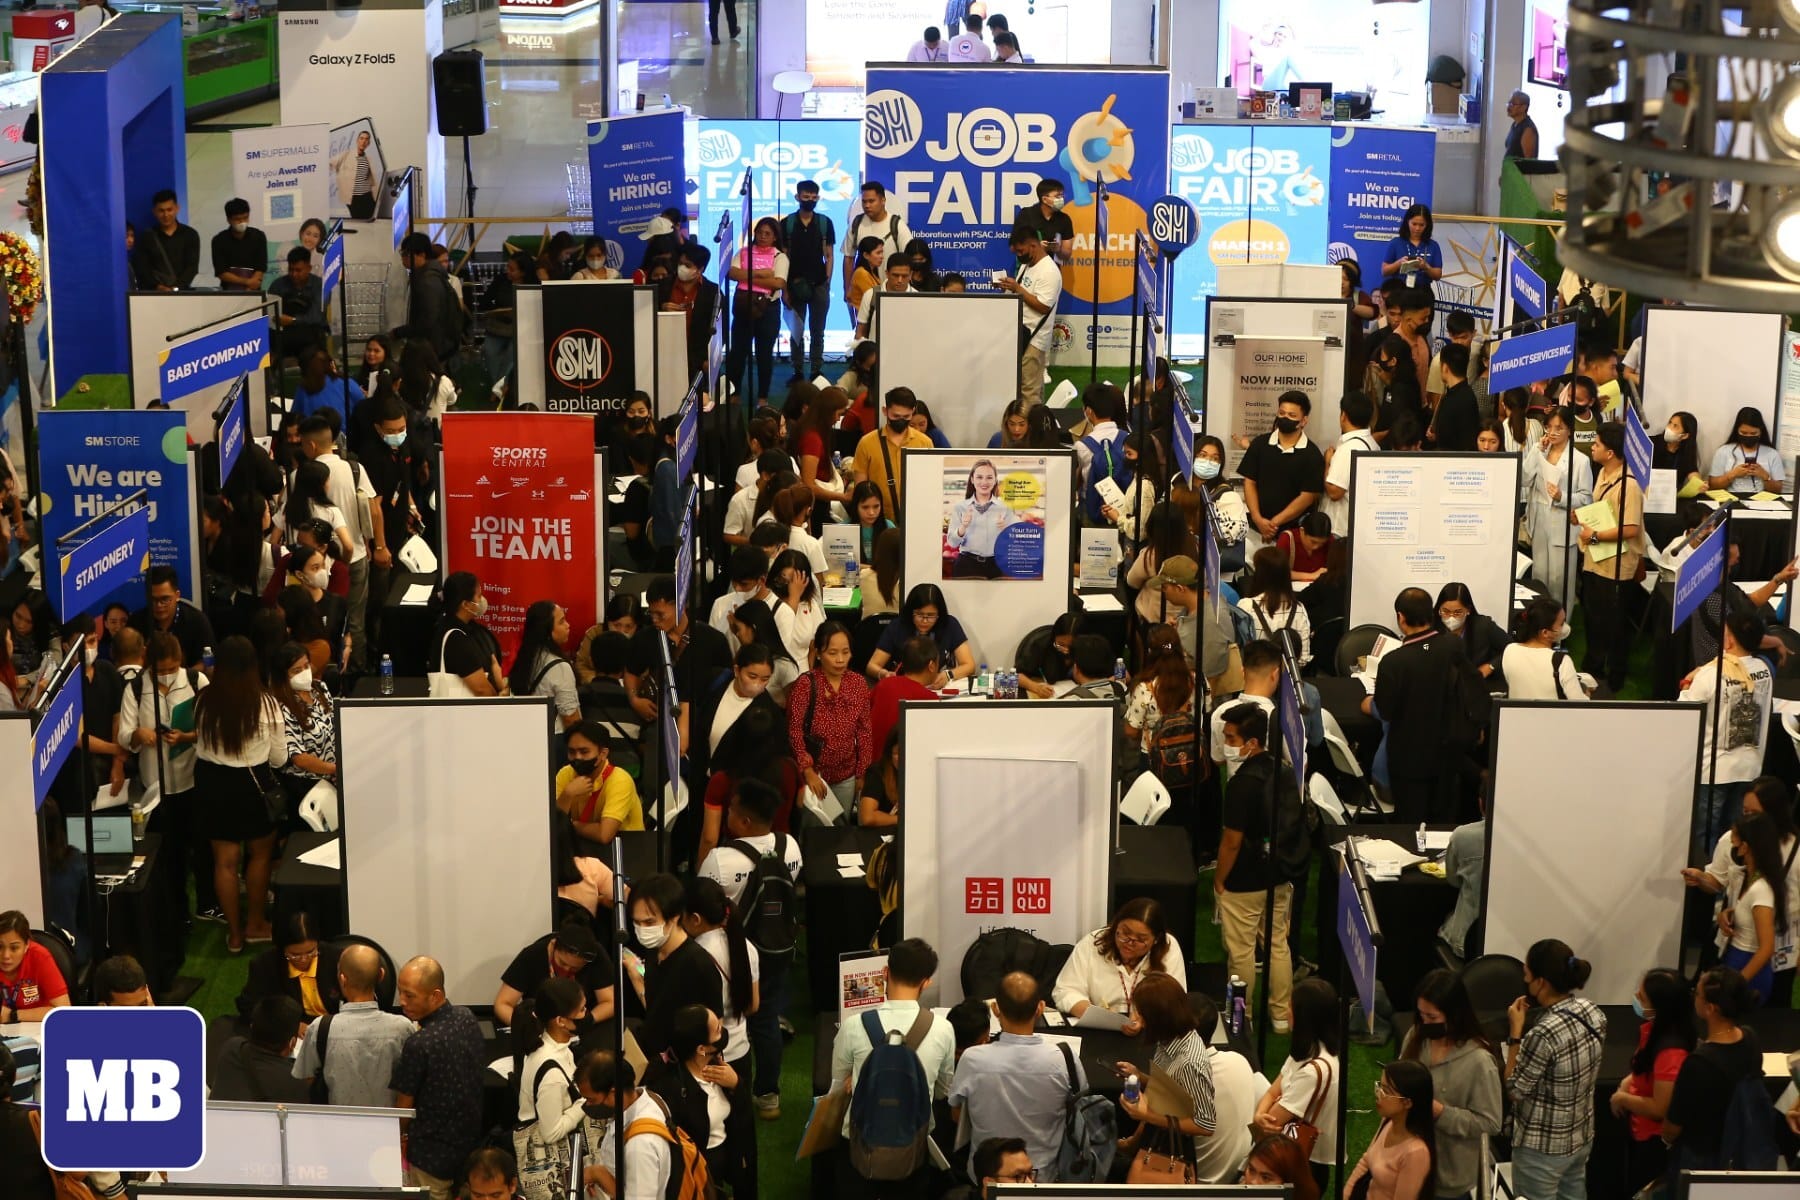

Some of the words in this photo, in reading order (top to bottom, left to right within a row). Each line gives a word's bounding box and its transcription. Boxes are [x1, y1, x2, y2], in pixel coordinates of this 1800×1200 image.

[309, 54, 352, 66] Galaxy
[354, 54, 362, 64] Z
[363, 53, 396, 64] Fold5
[866, 97, 914, 150] SM
[925, 107, 1059, 168] JOB
[621, 143, 633, 151] SM
[246, 151, 261, 160] SM
[741, 141, 829, 173] JOB
[1213, 146, 1300, 177] JOB
[248, 170, 261, 178] Are
[262, 169, 278, 179] you
[278, 164, 317, 176] AweSM?
[623, 173, 639, 183] We
[640, 172, 655, 180] are
[266, 181, 284, 189] Join
[285, 178, 298, 187] us!
[608, 180, 672, 202] HIRING!
[1178, 175, 1278, 205] FAIR
[1365, 182, 1381, 192] We
[1383, 185, 1400, 193] are
[894, 170, 1043, 225] FAIR
[1347, 193, 1415, 210] HIRING!
[1152, 202, 1188, 244] SM
[1360, 212, 1372, 220] Join
[952, 230, 970, 239] with
[971, 230, 993, 239] PSAC
[934, 241, 988, 249] PHILEXPORT
[1211, 241, 1273, 252] MARCH
[1277, 241, 1286, 251] 1
[167, 359, 200, 384] BABY
[200, 338, 262, 370] COMPANY
[556, 336, 602, 380] SM
[1254, 354, 1274, 362] OUR
[1278, 354, 1306, 362] HOME
[1492, 358, 1518, 374] MYRIAD
[1518, 356, 1529, 367] ICT
[1529, 347, 1560, 365] SERVICES
[1240, 375, 1271, 385] NOW
[1274, 376, 1317, 386] HIRING!
[85, 436, 104, 446] SM
[104, 436, 140, 446] STORE
[493, 447, 547, 459] SPORTS
[492, 458, 547, 468] CENTRAL
[66, 464, 113, 487] We
[117, 469, 162, 487] are
[74, 494, 158, 522] Hiring
[471, 516, 524, 535] JOIN
[531, 518, 571, 535] THE
[470, 533, 572, 561] TEAM!
[75, 538, 135, 591] STATIONERY
[1677, 558, 1714, 606] COLLECTIONS
[501, 605, 525, 613] Store
[39, 701, 74, 777] ALFAMART
[1017, 881, 1044, 894] UNI
[1017, 897, 1046, 911] QLO
